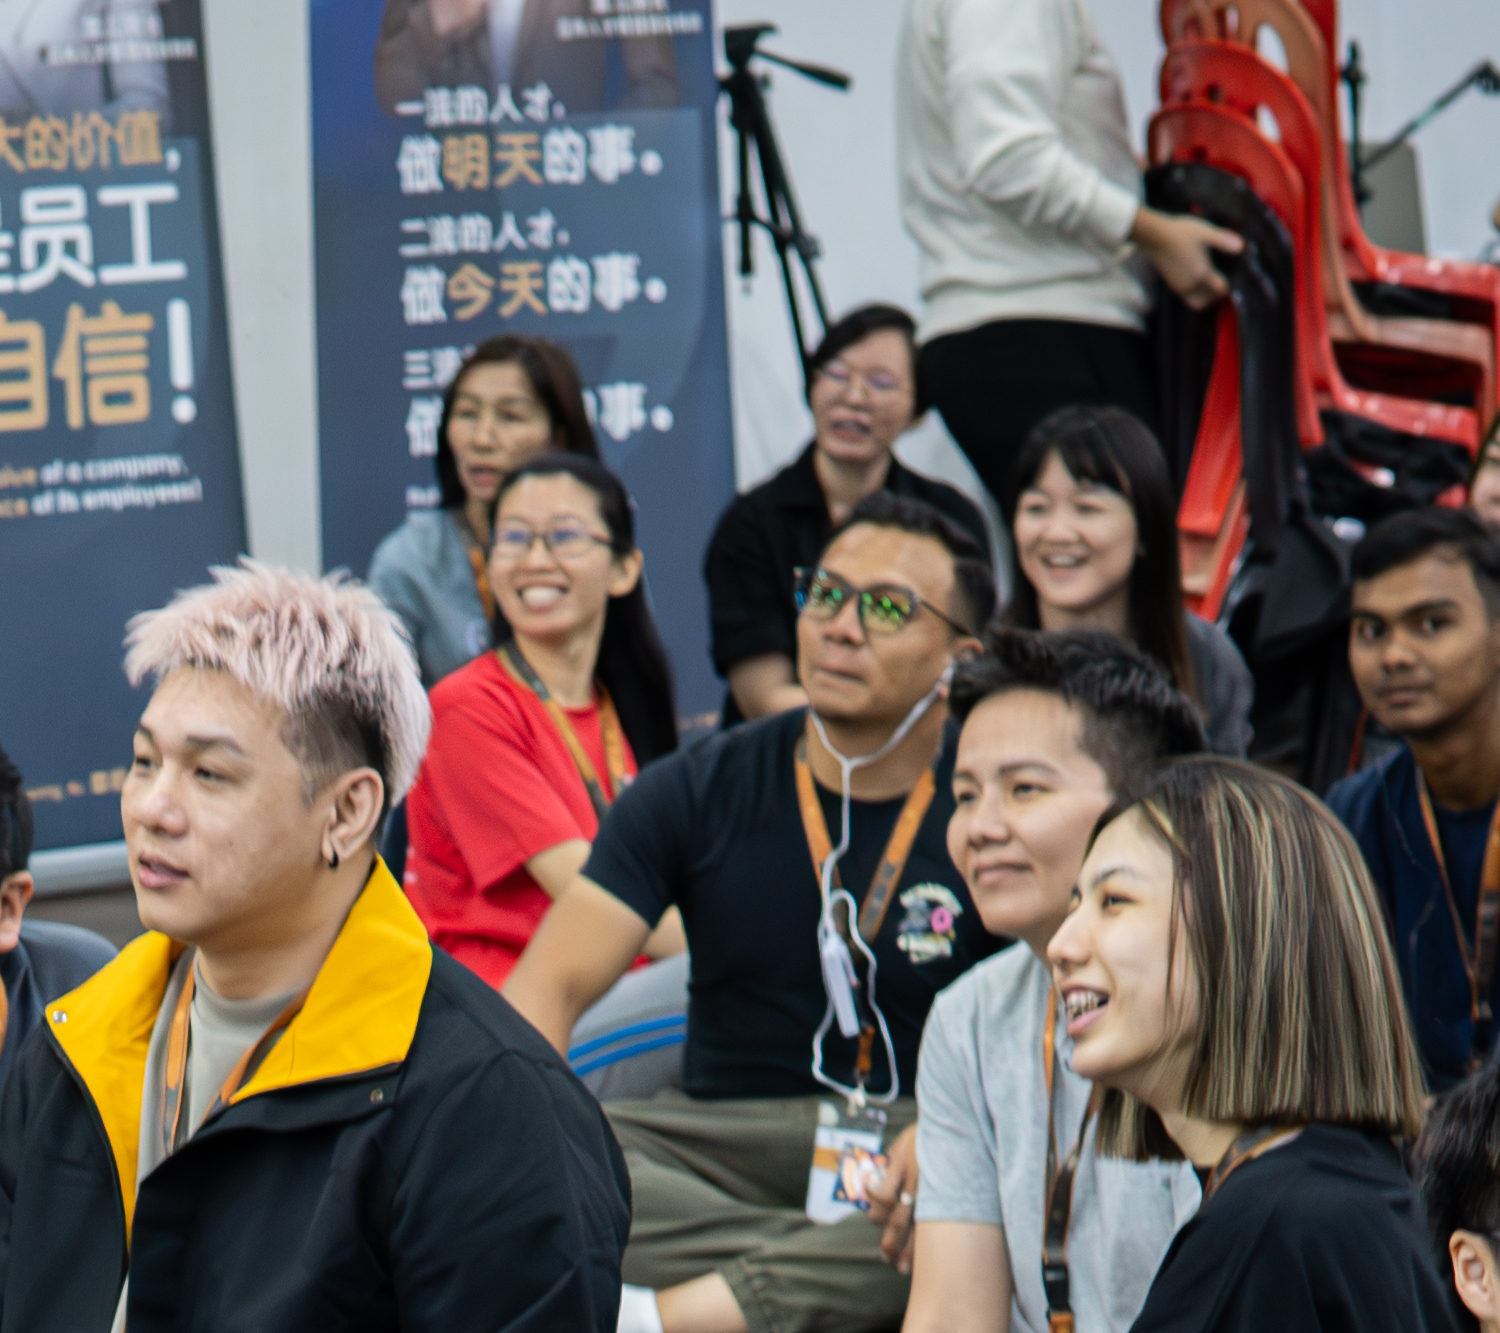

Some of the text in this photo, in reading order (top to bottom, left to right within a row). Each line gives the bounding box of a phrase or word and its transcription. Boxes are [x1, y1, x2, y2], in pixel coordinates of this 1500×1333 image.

[396, 122, 664, 195] 做明天的事。
[401, 250, 668, 326] 做今天的事。
[39, 457, 65, 486] of
[30, 490, 55, 516] of
